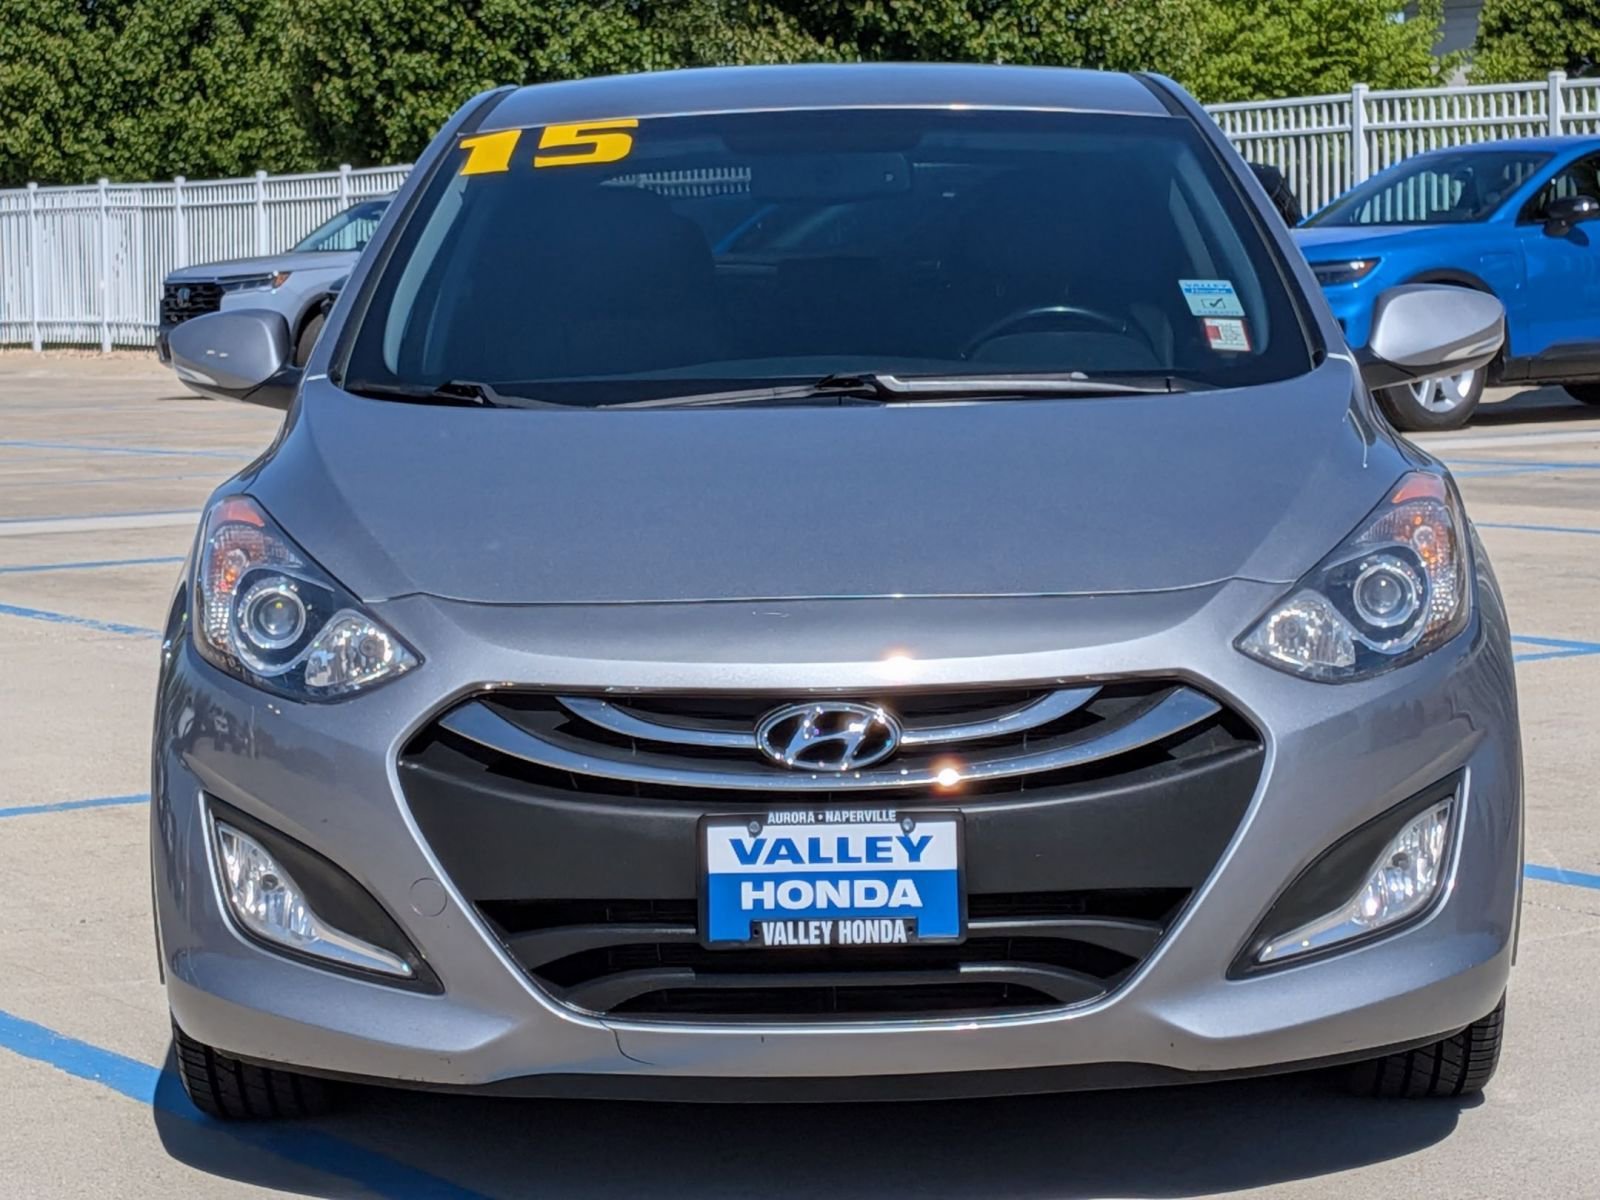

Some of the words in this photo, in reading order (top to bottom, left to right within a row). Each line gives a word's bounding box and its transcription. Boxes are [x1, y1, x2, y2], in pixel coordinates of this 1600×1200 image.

[459, 118, 639, 176] 15
[767, 811, 815, 825] AURORA
[825, 809, 897, 823] NAPERVILLE
[729, 835, 934, 865] VALLEY
[740, 879, 923, 910] HONDA
[761, 920, 834, 946] VALLEY
[838, 919, 908, 944] HONDA
